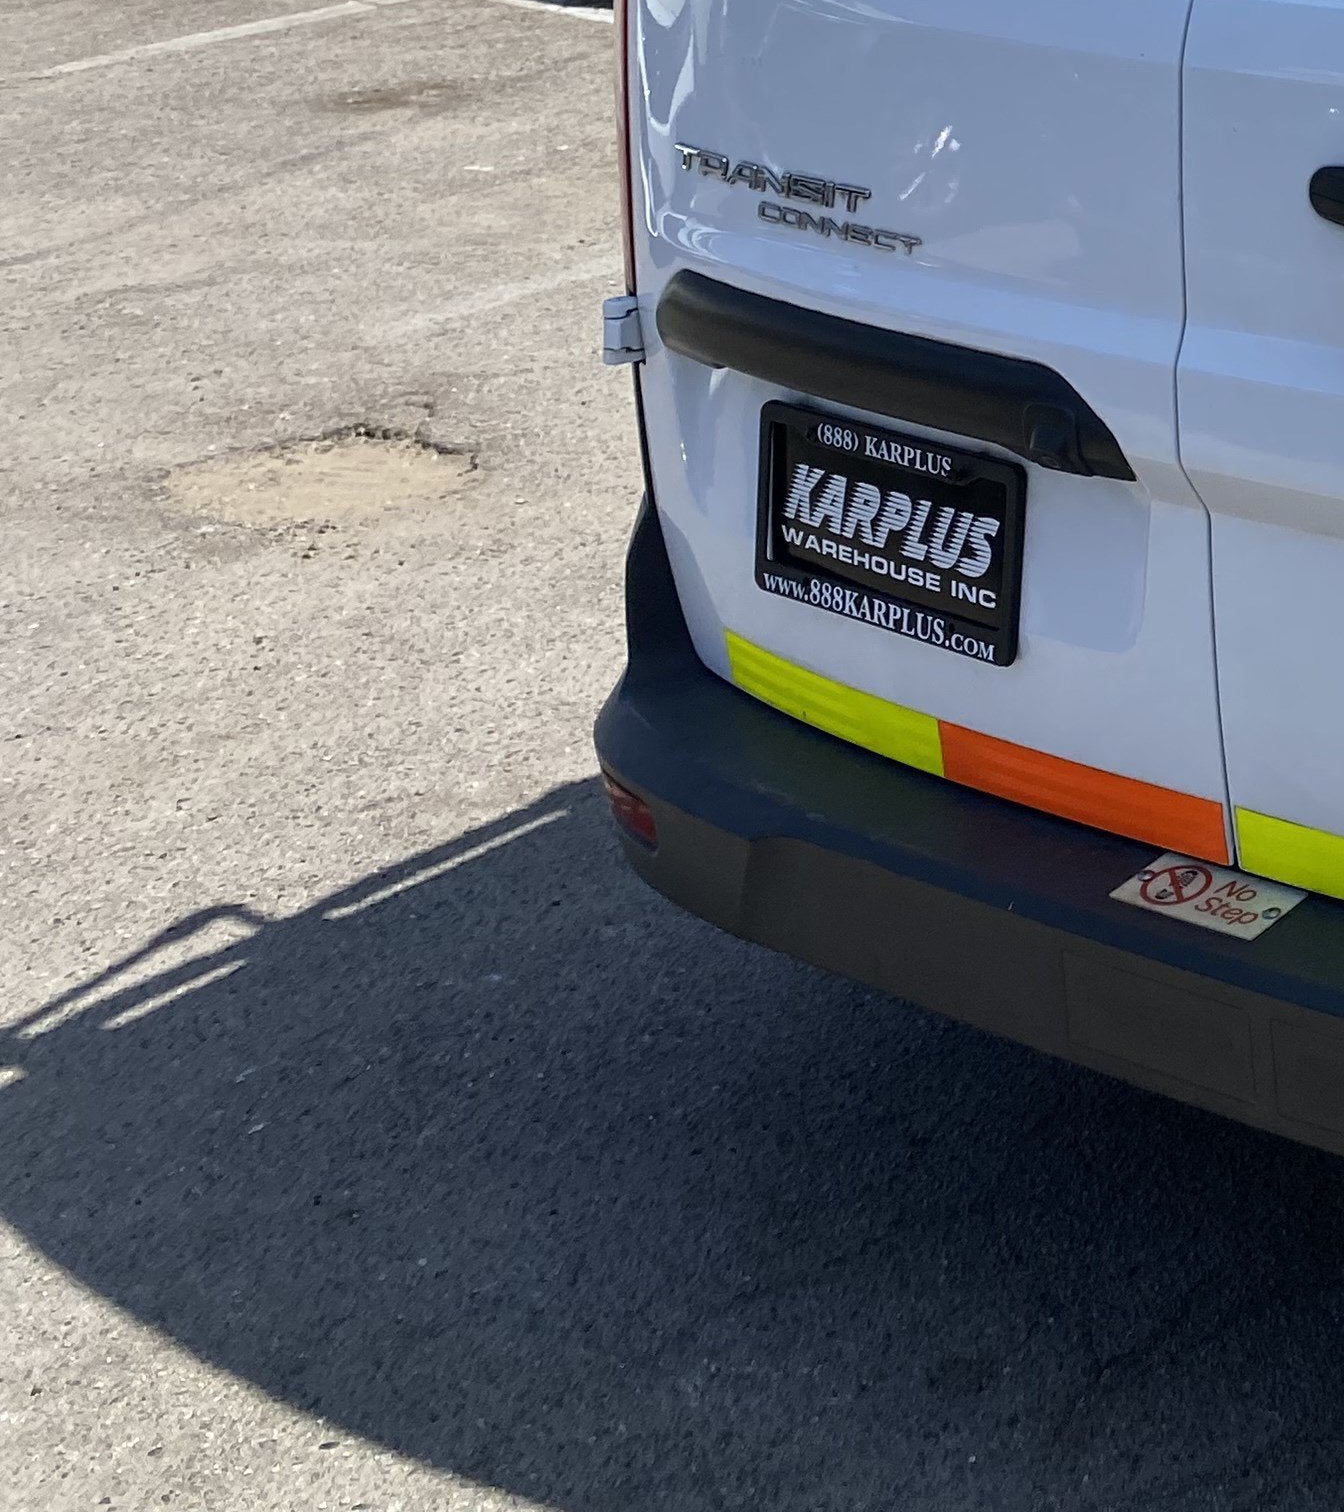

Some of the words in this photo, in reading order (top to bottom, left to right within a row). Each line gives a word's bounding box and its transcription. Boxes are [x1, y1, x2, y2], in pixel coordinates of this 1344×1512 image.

[674, 142, 872, 213] TRANSIT
[757, 200, 922, 254] CONNECT
[816, 422, 859, 452] (888)
[864, 435, 951, 477] KARPLUS
[781, 463, 1000, 578] KARPLUS
[781, 524, 941, 592] WAREHOUSE
[951, 579, 997, 609] INC
[1194, 896, 1258, 925] Step
[1213, 880, 1257, 901] No
